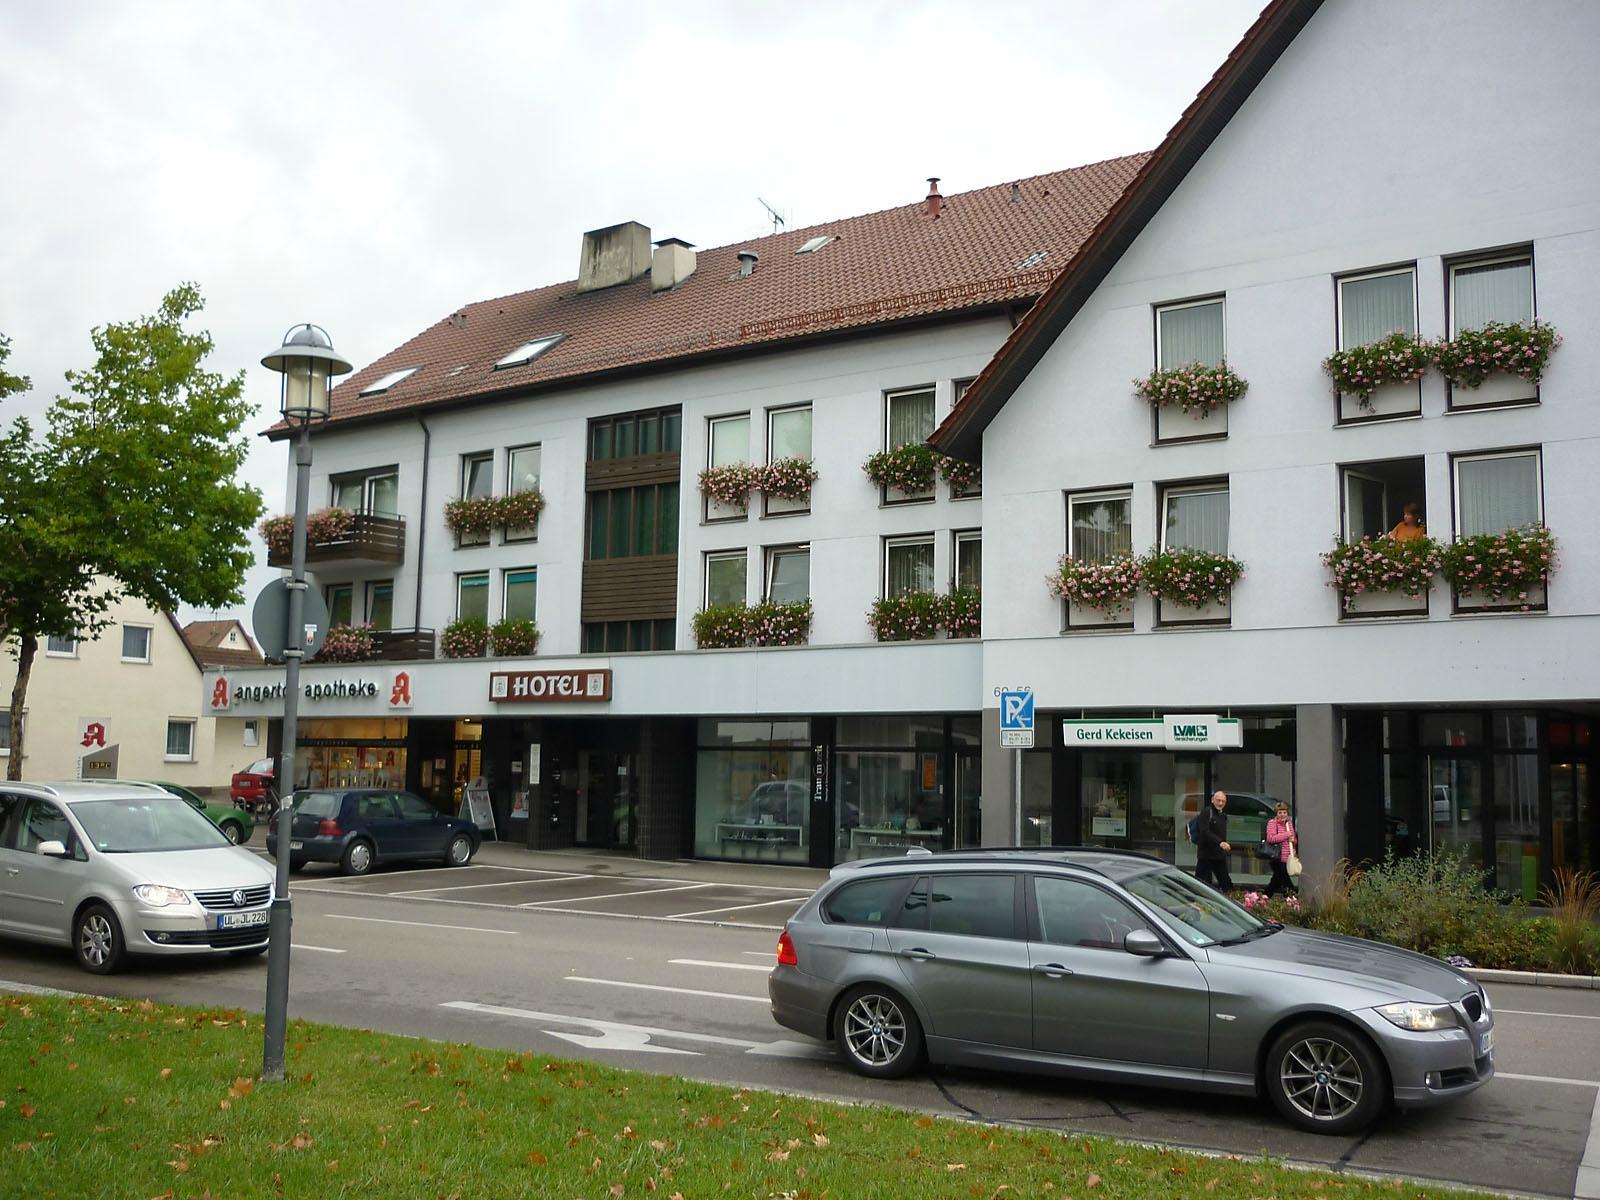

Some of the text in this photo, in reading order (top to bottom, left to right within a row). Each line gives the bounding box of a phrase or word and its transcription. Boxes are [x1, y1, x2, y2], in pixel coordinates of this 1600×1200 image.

[305, 678, 378, 701] apotheke
[513, 675, 584, 696] HOTEL
[1076, 728, 1153, 741] Gerd Kekeisen
[1173, 725, 1196, 737] LVM
[252, 912, 266, 922] 228
